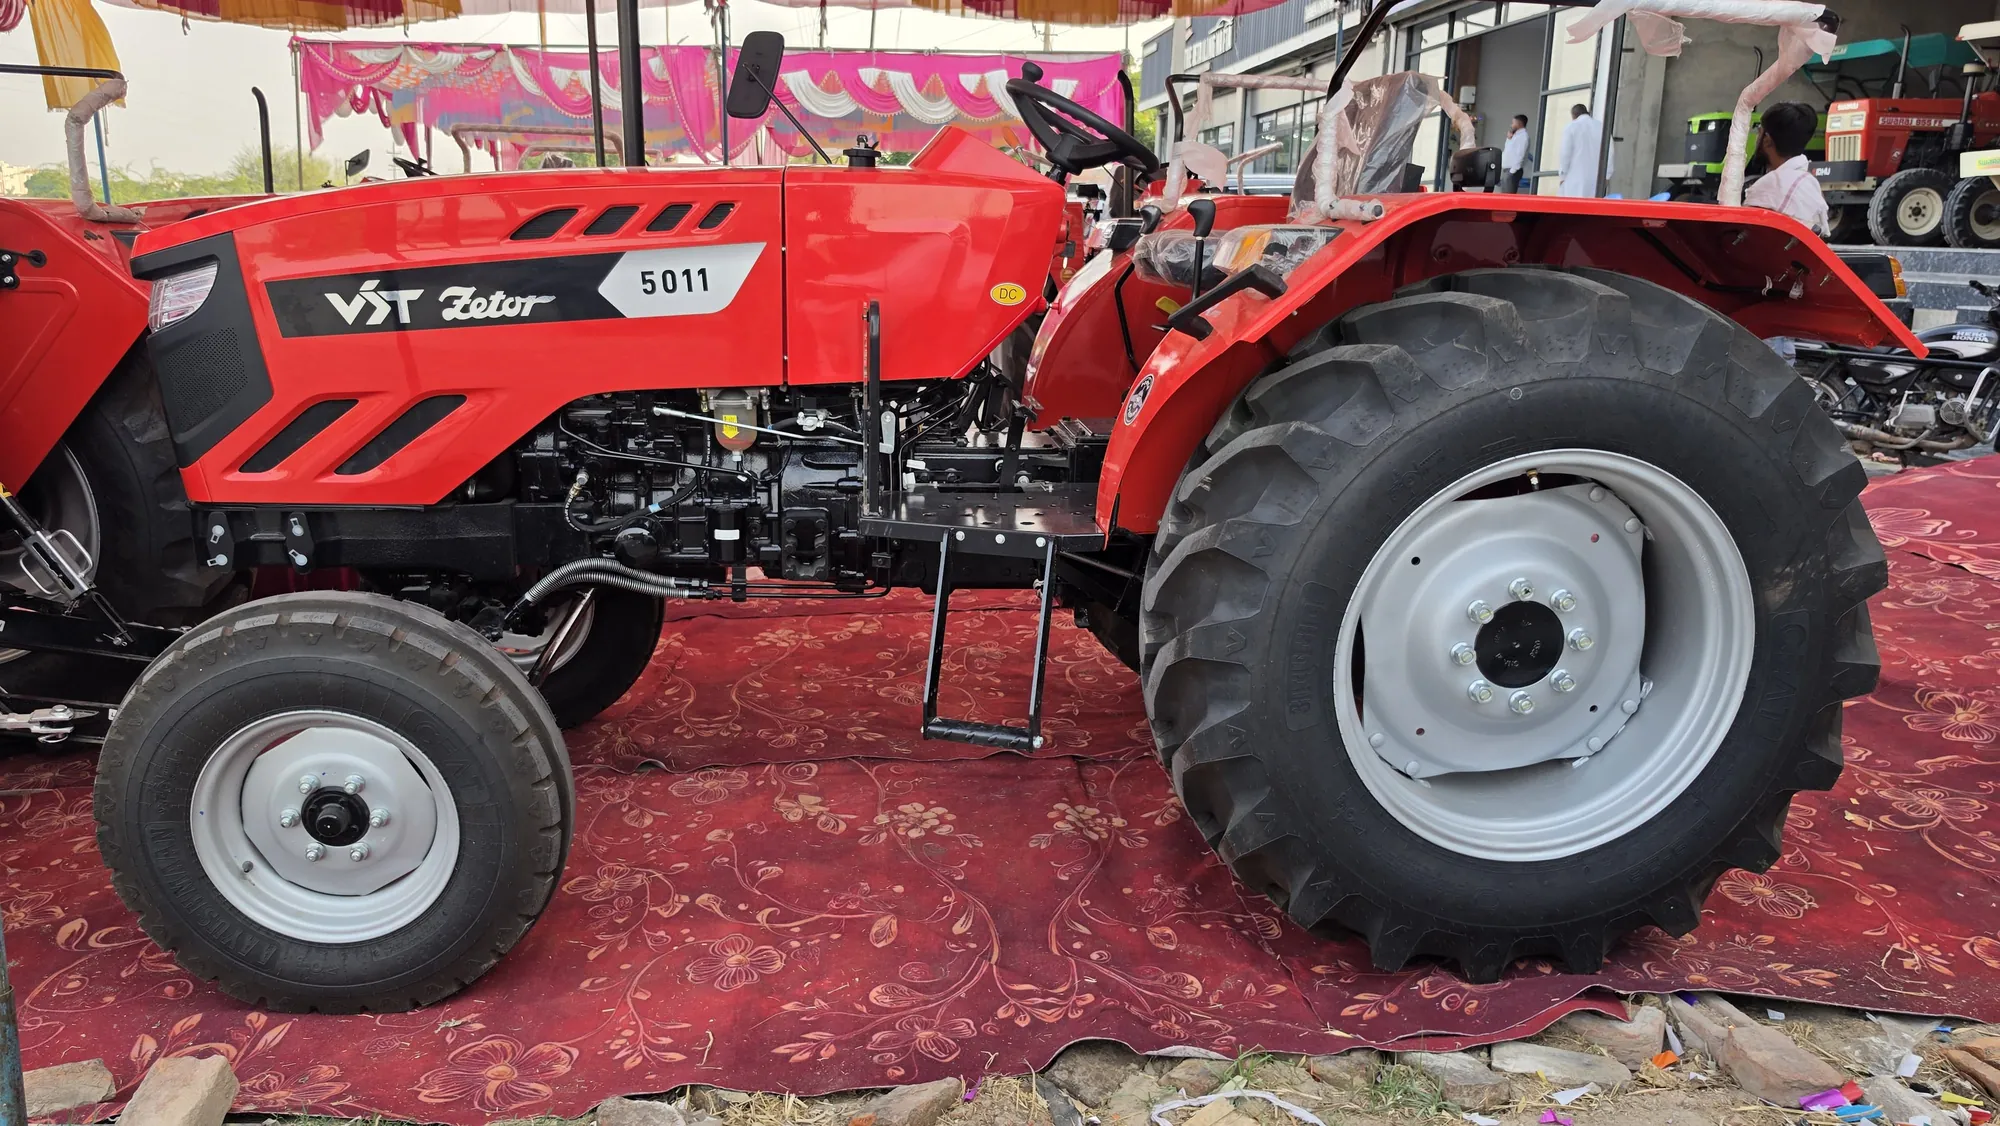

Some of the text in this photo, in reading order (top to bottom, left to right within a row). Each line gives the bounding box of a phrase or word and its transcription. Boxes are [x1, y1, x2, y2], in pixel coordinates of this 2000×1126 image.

[323, 267, 710, 325] VST Zetor 5011
[999, 287, 1018, 300] DC
